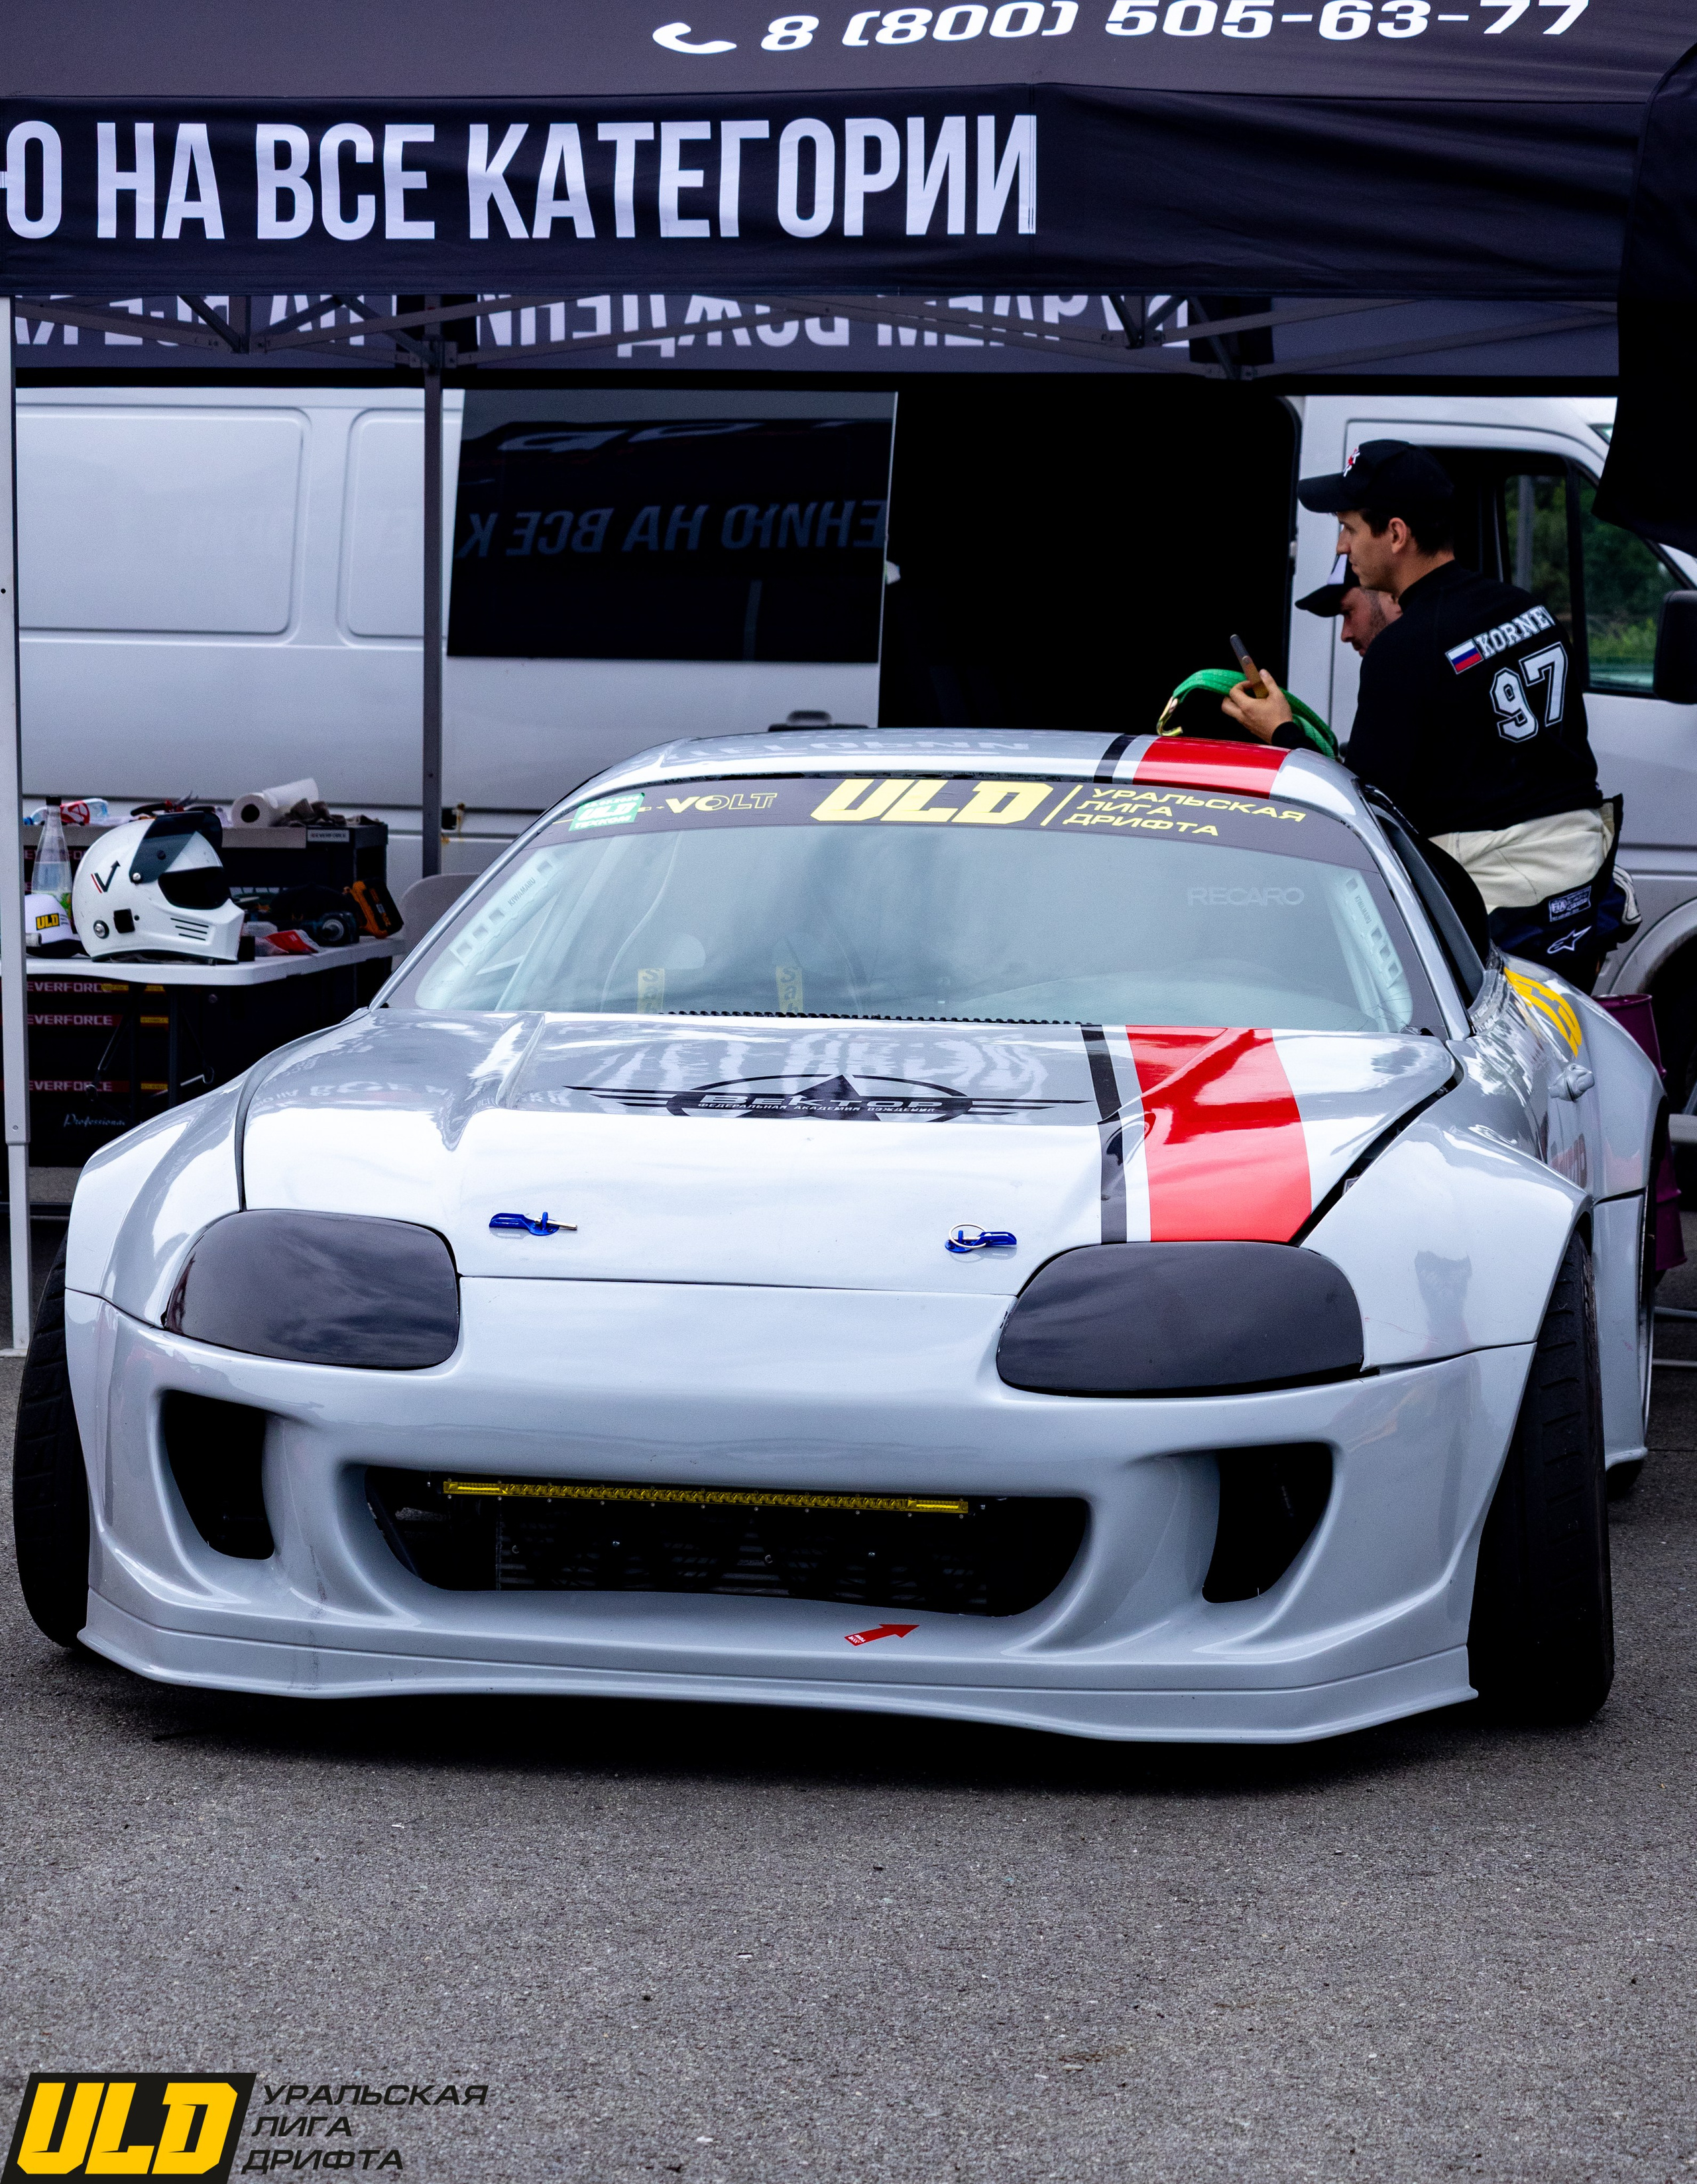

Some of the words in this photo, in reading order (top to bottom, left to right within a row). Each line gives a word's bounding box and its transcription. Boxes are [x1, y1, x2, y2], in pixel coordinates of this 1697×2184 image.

[761, 15, 819, 51] 8
[1104, 0, 1589, 40] 505-63-77
[97, 122, 225, 239] НА
[256, 123, 436, 241] ВСЕ
[467, 115, 1037, 239] КАТЕГОРИИ
[1490, 642, 1568, 743] 97
[665, 792, 778, 814] VOLT
[810, 778, 1054, 825] ULD
[1076, 800, 1173, 817] ЛИГА
[1092, 788, 1307, 822] УРАЛЬСКАЯ
[1062, 812, 1219, 837] ДРИФТА
[507, 877, 536, 907] KIWAMARU
[1187, 886, 1305, 906] RECARO
[36, 914, 59, 929] ULD
[27, 981, 113, 993] EVERFORC
